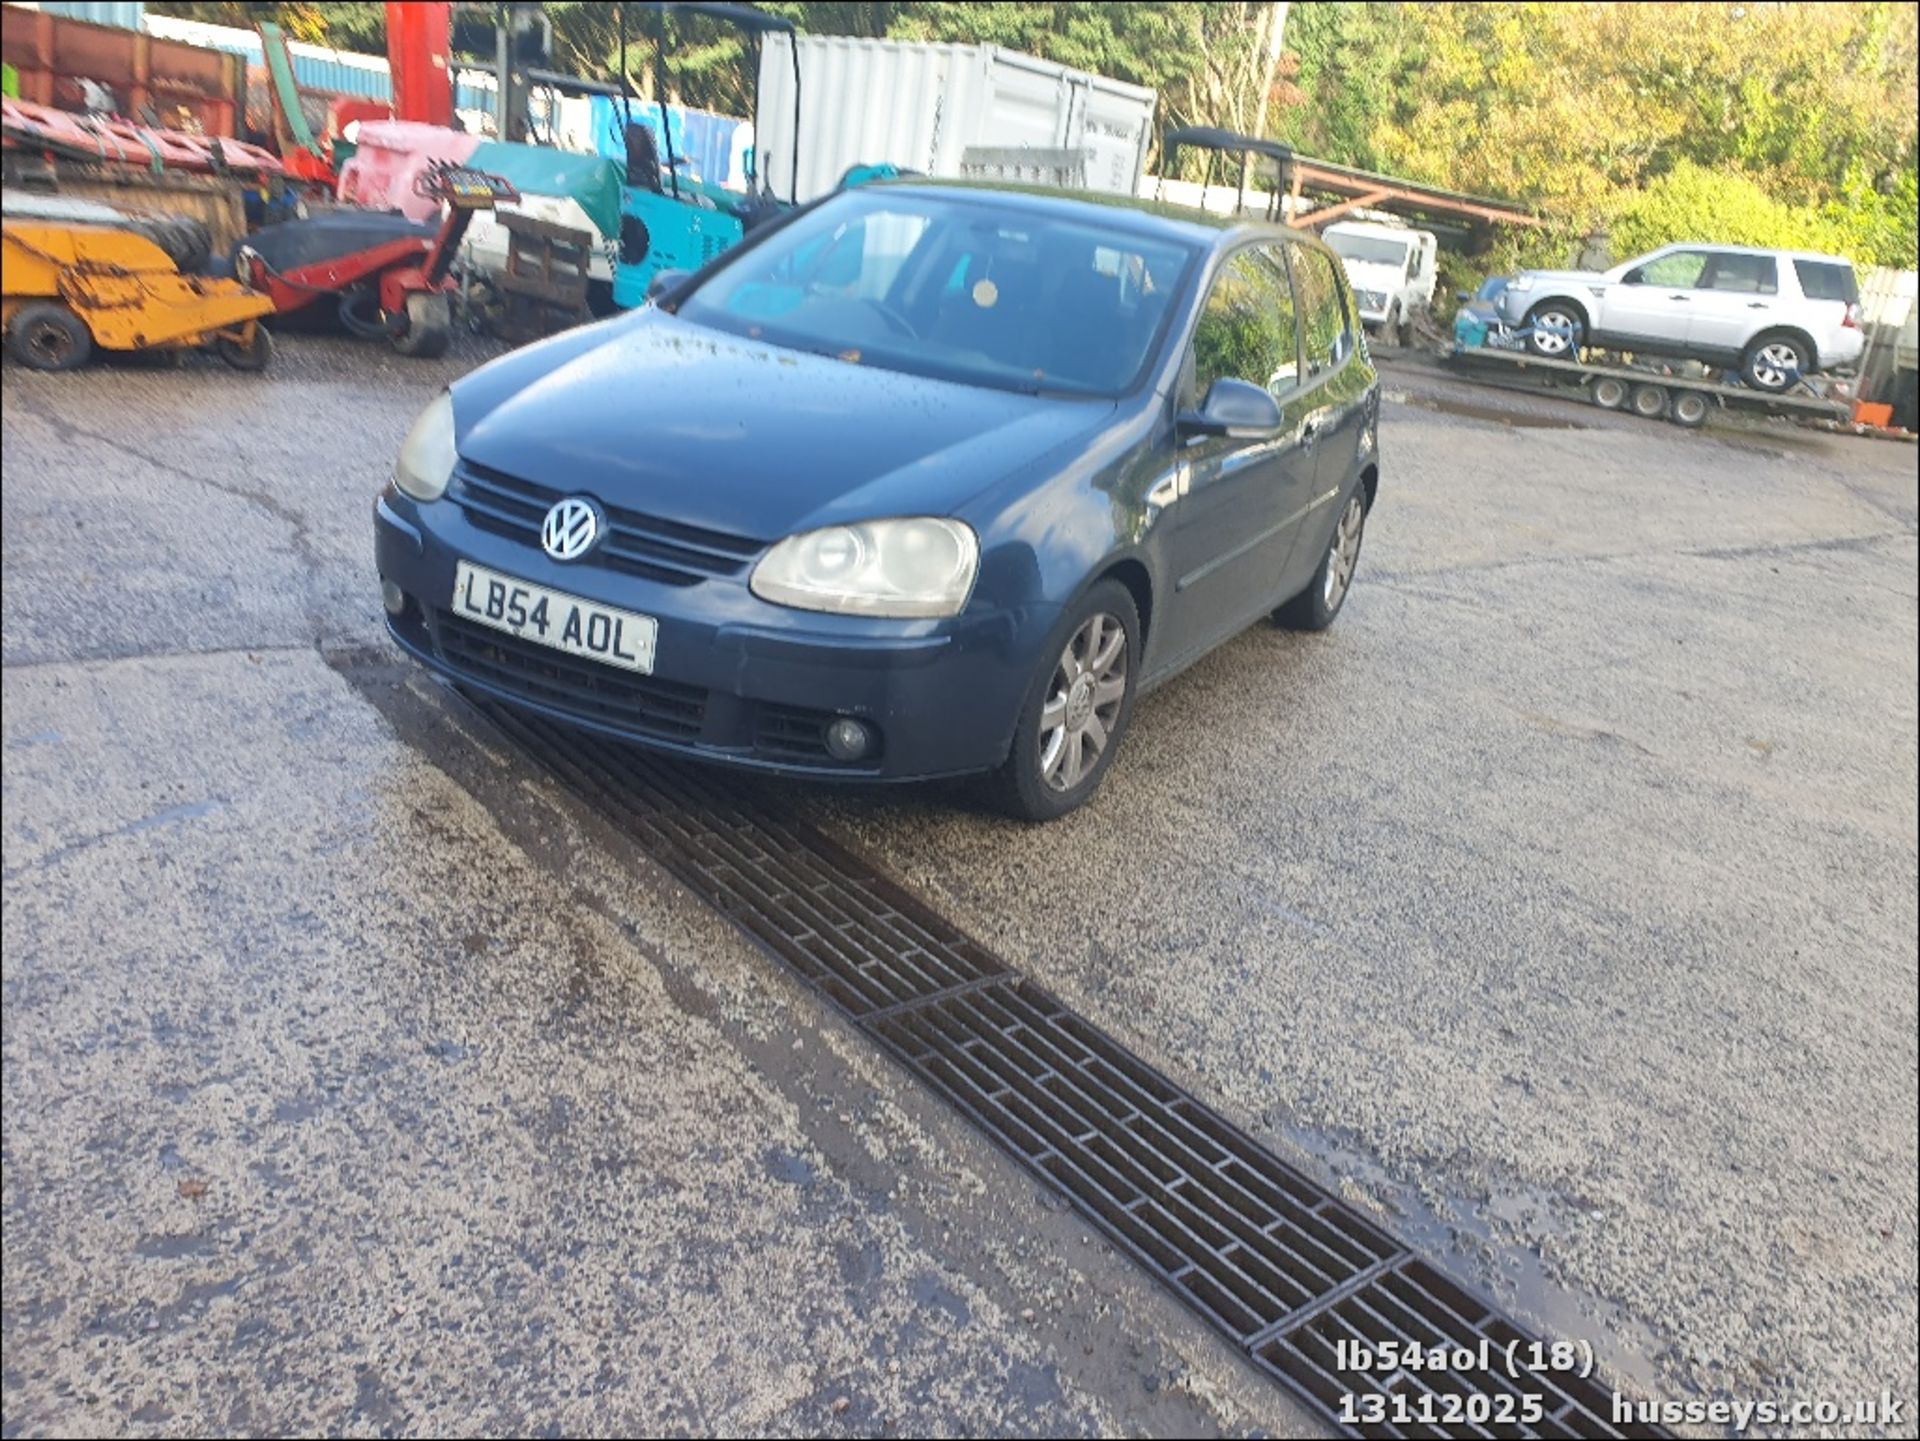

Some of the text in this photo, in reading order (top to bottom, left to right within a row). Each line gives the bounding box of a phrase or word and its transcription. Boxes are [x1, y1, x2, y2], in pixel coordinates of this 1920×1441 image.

[541, 499, 597, 560] VW
[464, 571, 636, 662] LB54 AOL
